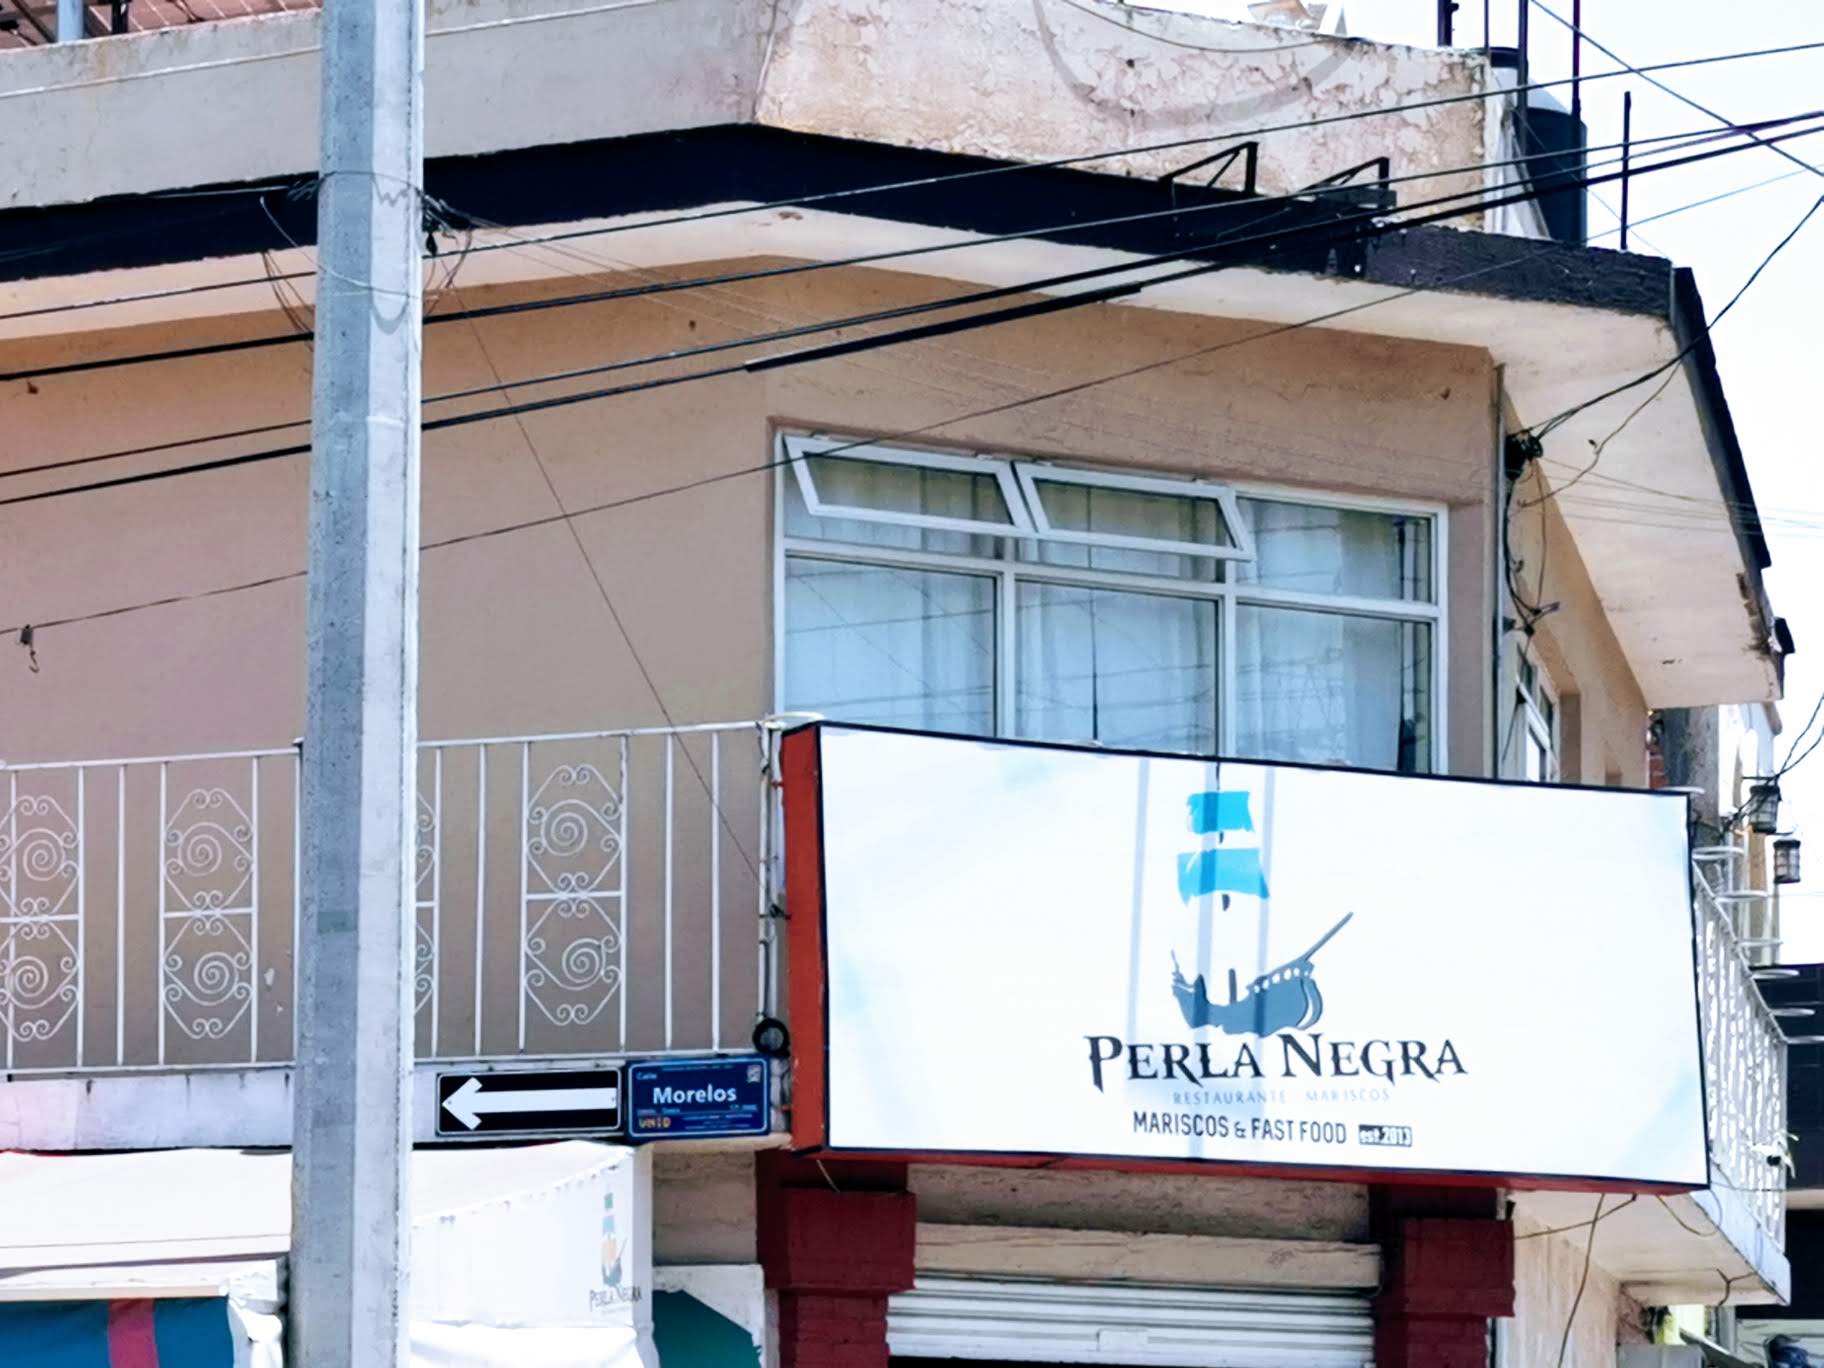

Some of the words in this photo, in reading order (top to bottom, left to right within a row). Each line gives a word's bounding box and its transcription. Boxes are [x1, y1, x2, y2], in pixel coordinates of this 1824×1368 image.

[1083, 1035, 1266, 1093] PERLA
[1277, 1033, 1468, 1085] NEGRA
[652, 1083, 738, 1104] Morelos
[1172, 1089, 1286, 1105] RESTAURANTE
[1306, 1087, 1391, 1103] MARISCOS
[1132, 1111, 1229, 1138] MARISCOS
[1233, 1121, 1247, 1138] &
[1250, 1117, 1295, 1142] FAST
[1298, 1120, 1348, 1144] FOOD
